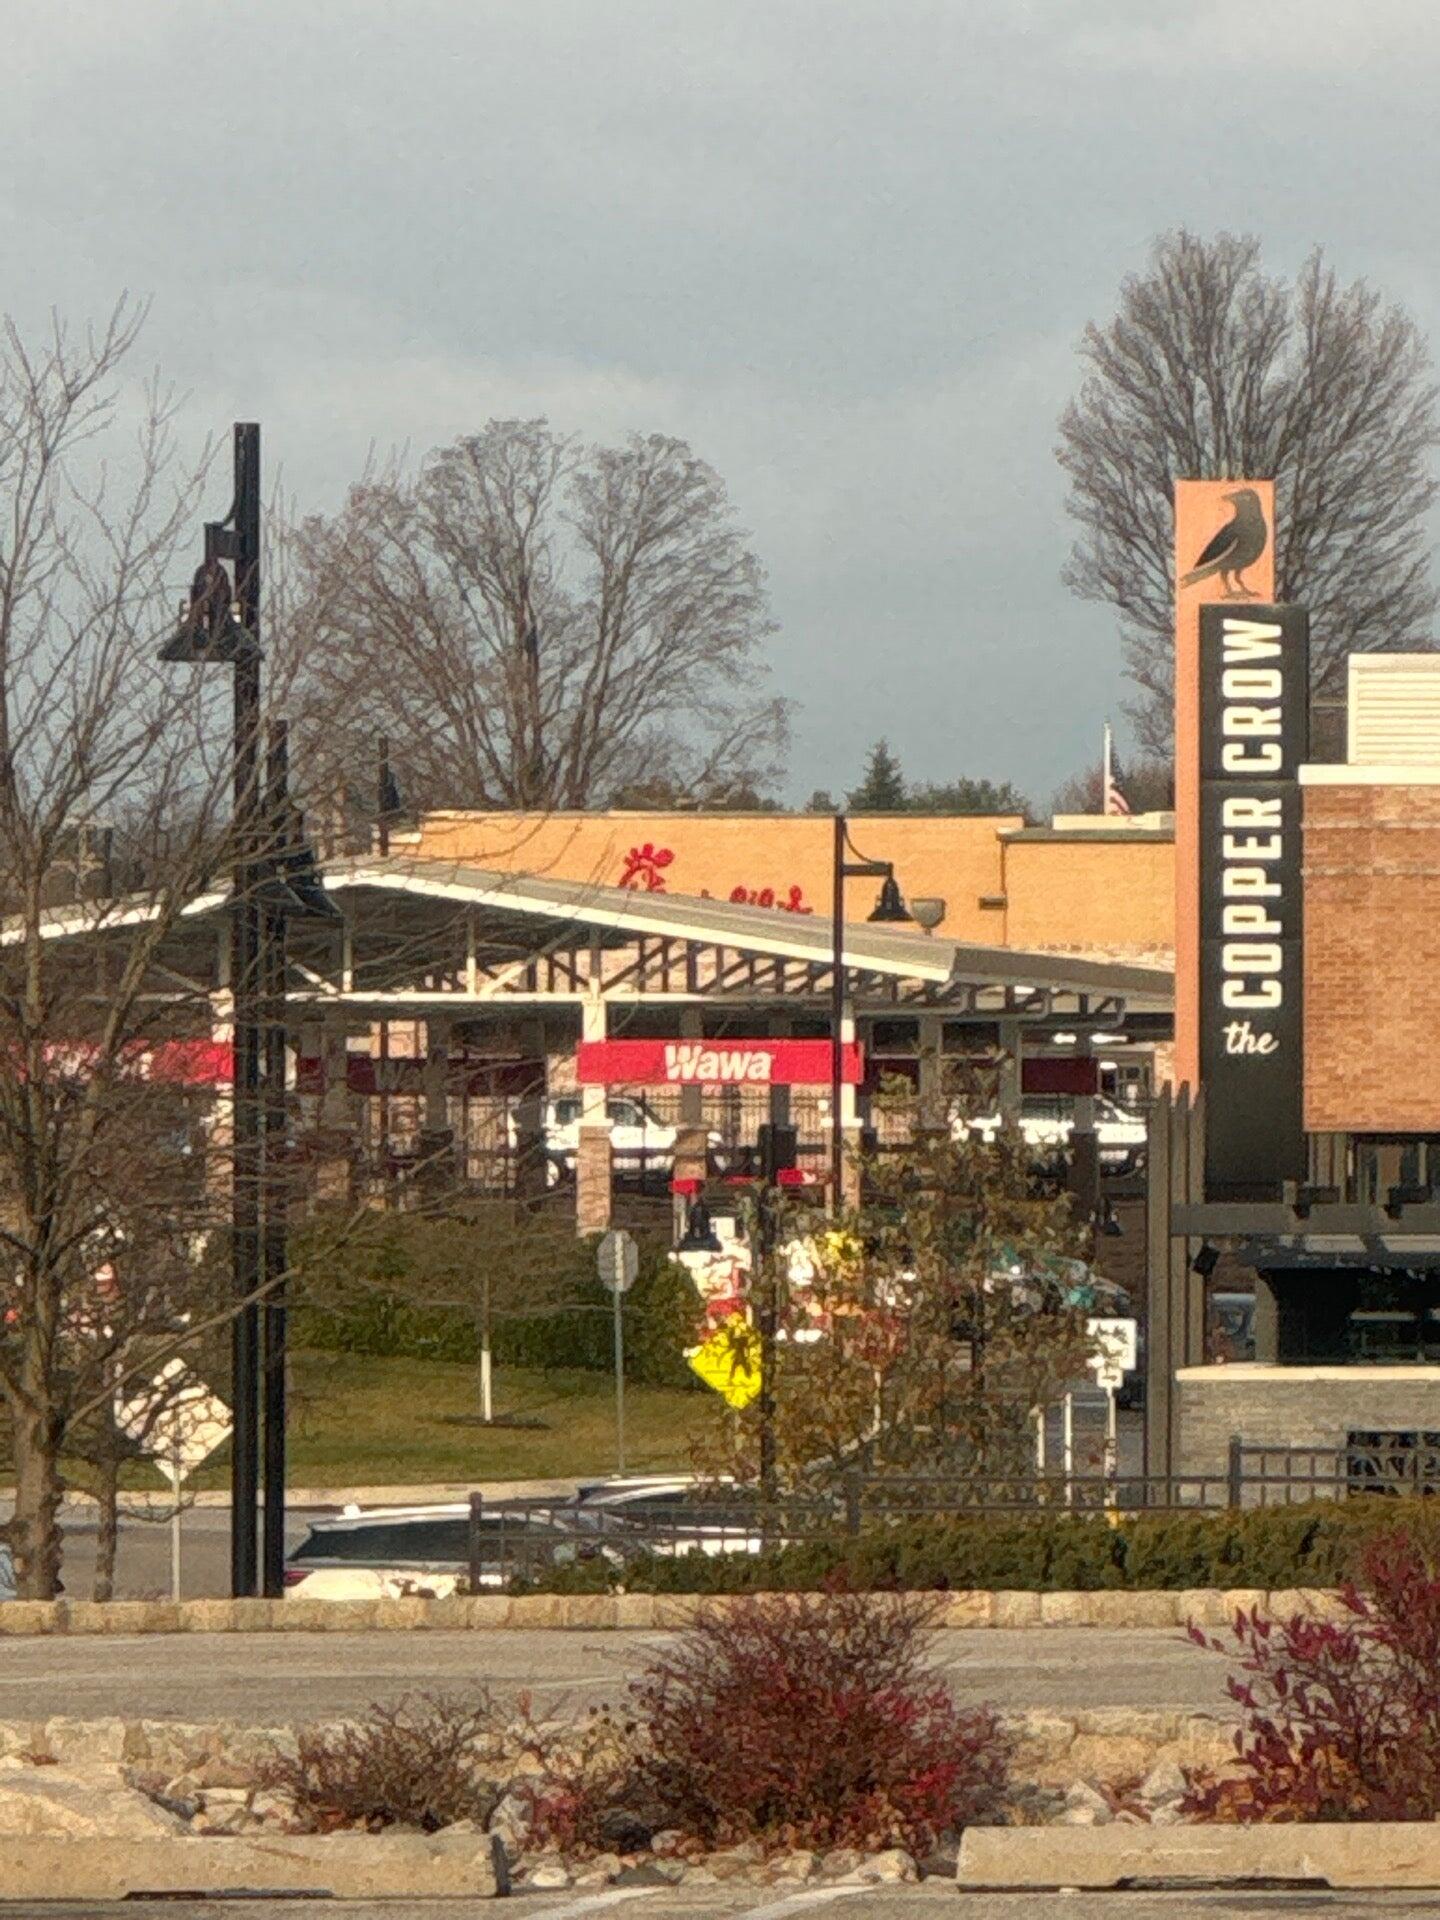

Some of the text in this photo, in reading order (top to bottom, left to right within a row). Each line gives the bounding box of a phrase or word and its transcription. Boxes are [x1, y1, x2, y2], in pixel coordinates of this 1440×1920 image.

[1222, 618, 1282, 1008] COPPER CROW
[1223, 1021, 1279, 1054] the
[664, 1045, 774, 1080] Wawa
